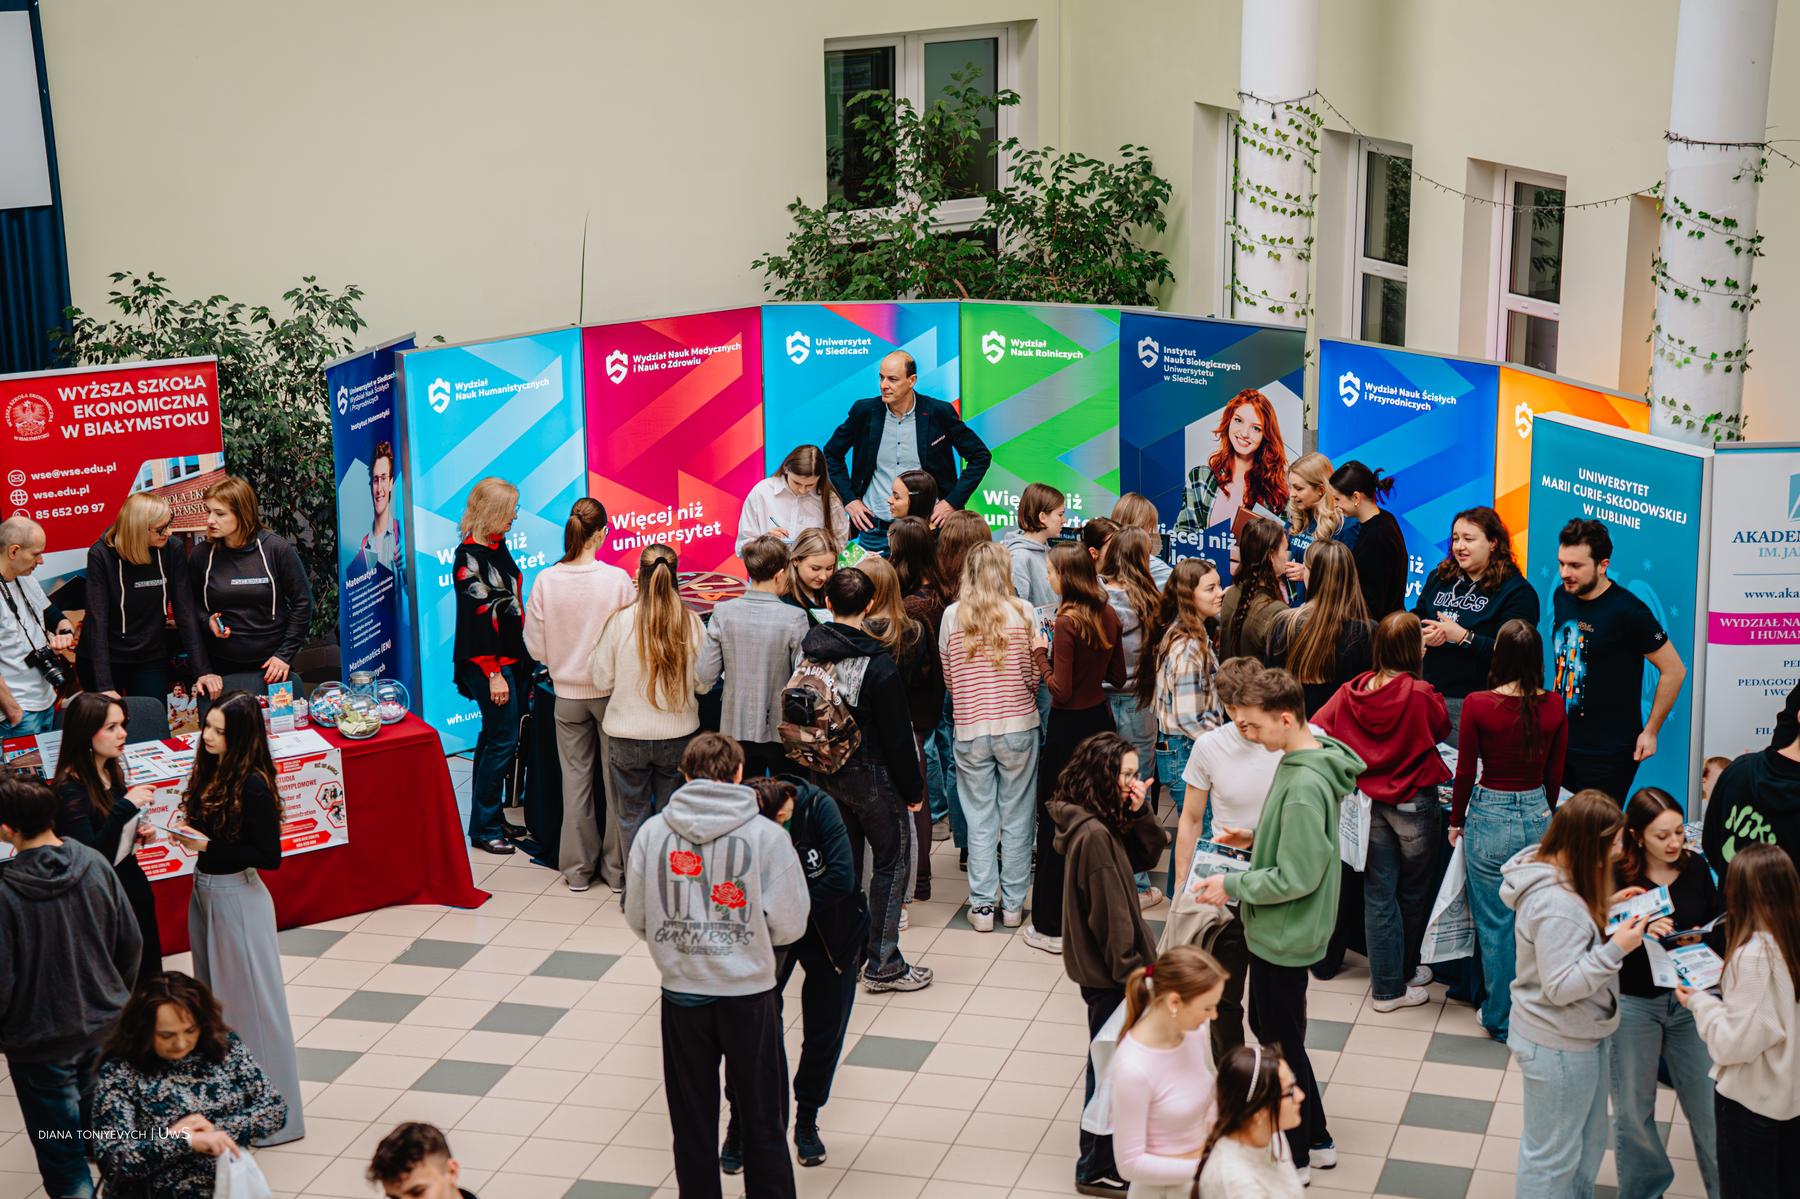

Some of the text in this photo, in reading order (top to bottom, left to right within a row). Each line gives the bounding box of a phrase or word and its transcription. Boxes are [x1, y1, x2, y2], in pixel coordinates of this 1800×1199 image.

[816, 338, 872, 347] Uniwersytet
[1011, 339, 1047, 349] Wydział
[633, 343, 742, 364] Wydział Nauk Medycznych
[826, 347, 869, 355] Siedlcach
[1011, 348, 1083, 360] Nauk Rolniczych
[1164, 346, 1197, 356] Instytut
[638, 362, 659, 373] Nauk
[668, 357, 701, 369] Zdrowiu
[1164, 356, 1241, 371] Nauk Biologicznych
[1164, 365, 1214, 377] Uniwersytetu
[455, 378, 488, 391] Wydział
[1172, 374, 1208, 385] Siedlcach
[58, 375, 206, 401] WYŻSZA SZKOŁA
[455, 378, 550, 401] Nauk Humanistycznych
[1365, 382, 1457, 405] Wydział Nauk Ścisłych
[73, 393, 208, 419] EKONOMICZNA
[1369, 393, 1431, 411] Przyrodniczych
[61, 412, 209, 439] W BIAŁYMSTOKU
[31, 463, 117, 481] wse@wse.edu.pl
[1578, 467, 1649, 497] UNIWERSYTET
[33, 485, 90, 500] wse.edu.pl
[983, 490, 1082, 511] Wię iż
[1542, 475, 1687, 525] MARII CURIE-SKŁODOWSKIEJ
[35, 503, 105, 520] 85 652 09 97
[612, 501, 704, 530] Więcej niż
[1583, 503, 1641, 530] W LUBLINIE
[612, 521, 721, 551] uniwersytet
[1157, 523, 1237, 551] ięcej niż
[1732, 530, 1800, 544] AKADE
[1781, 547, 1800, 559] JA
[1409, 555, 1424, 574] iż
[1744, 588, 1800, 598] www.aka
[1720, 618, 1800, 628] WYDZIAŁ NA
[1758, 631, 1800, 639] HUMA
[1784, 660, 1800, 668] PE
